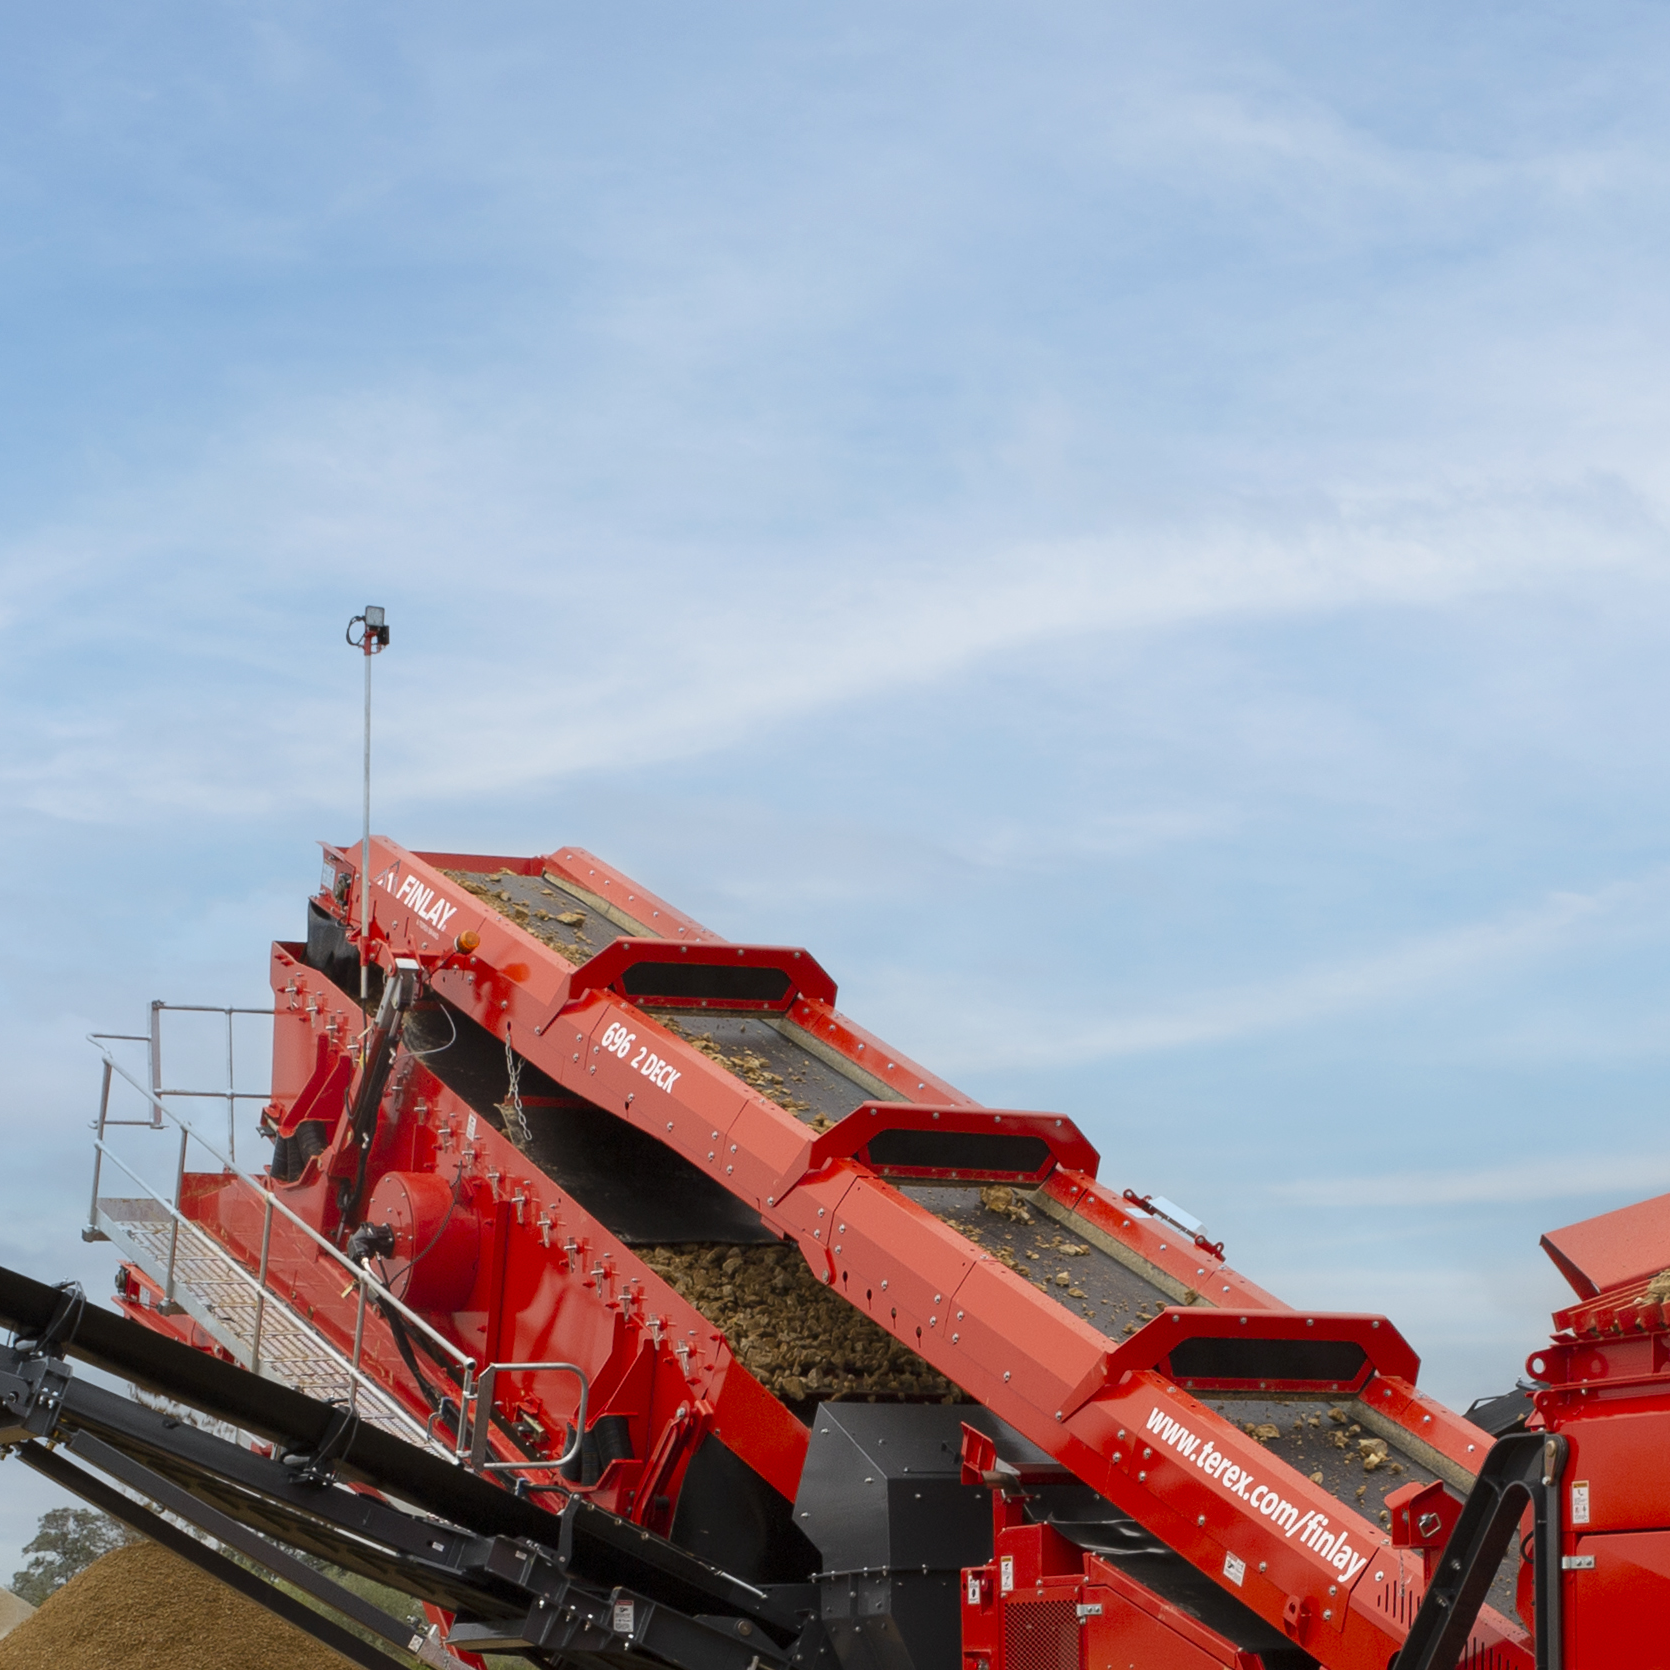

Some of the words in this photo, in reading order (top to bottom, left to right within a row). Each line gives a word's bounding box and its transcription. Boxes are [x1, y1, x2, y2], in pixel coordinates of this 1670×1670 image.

[601, 1021, 636, 1059] 696
[630, 1046, 648, 1069] 2
[640, 1053, 682, 1094] DECK
[1146, 1406, 1367, 1583] www.terex.com/finlay
